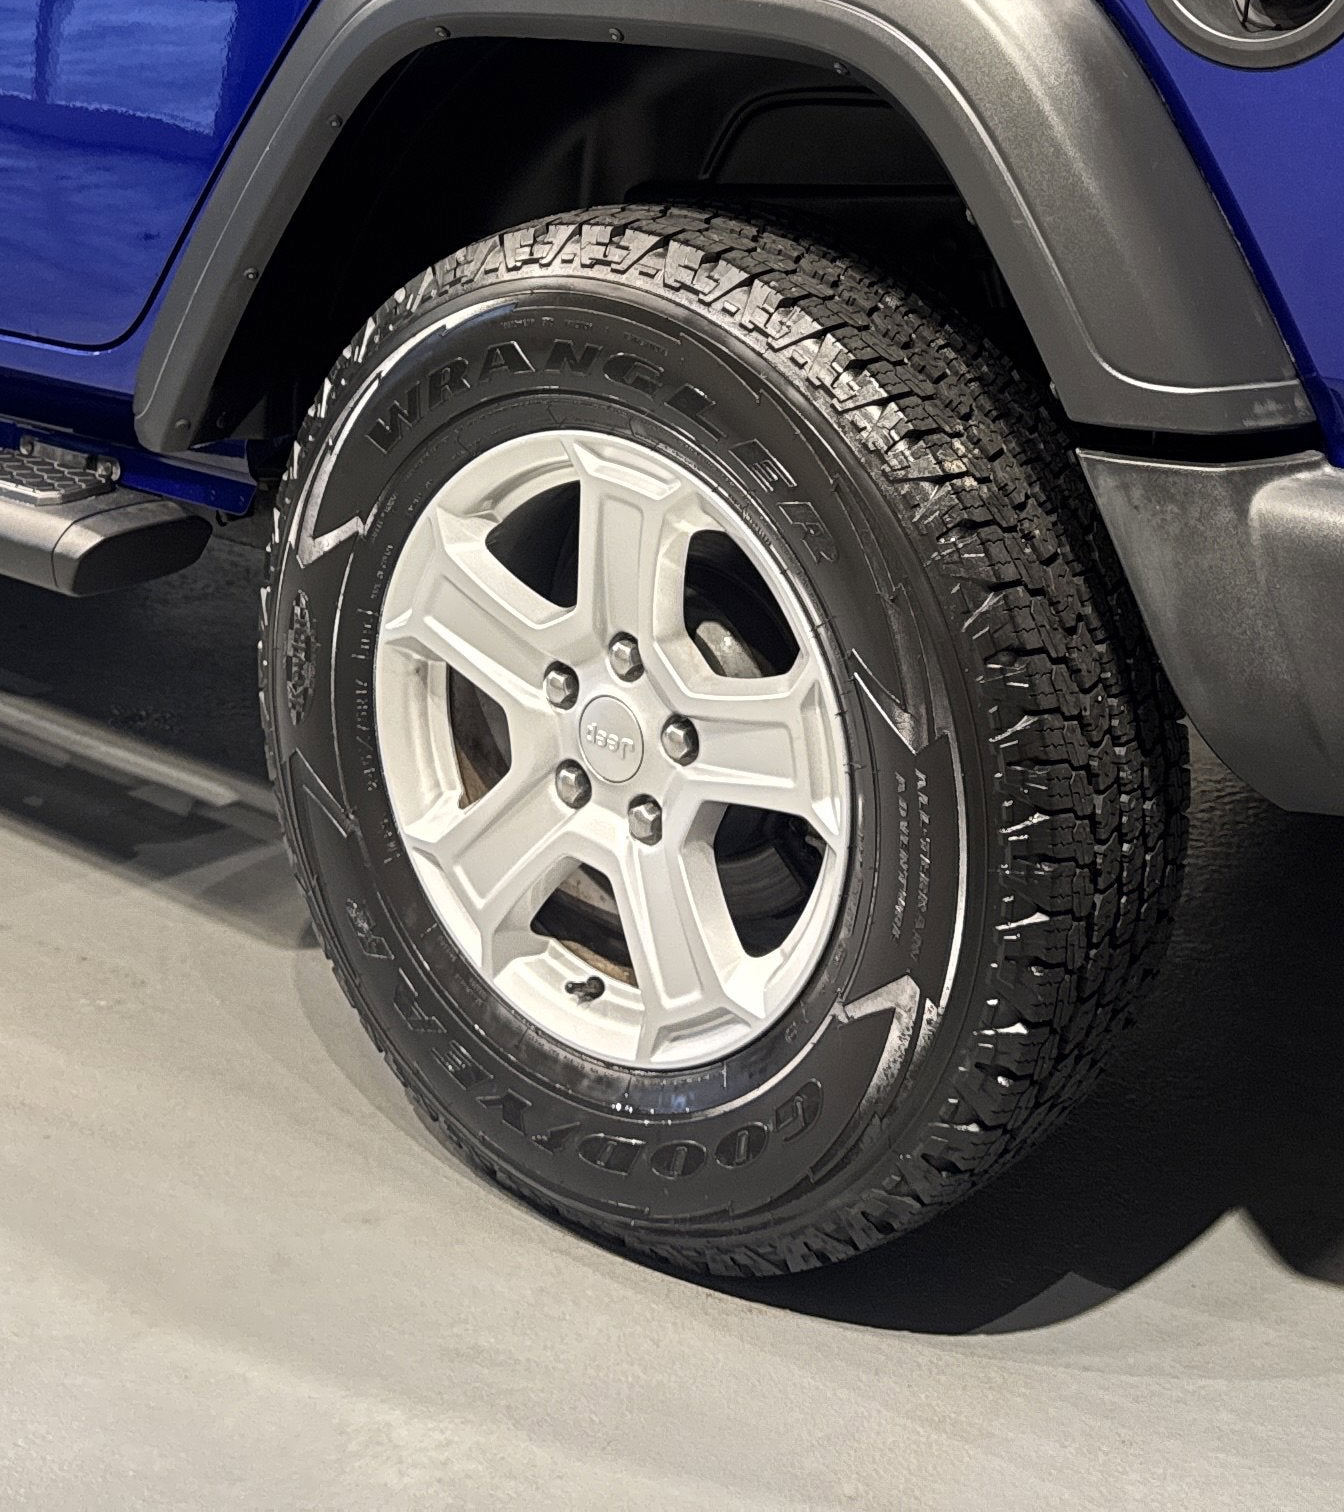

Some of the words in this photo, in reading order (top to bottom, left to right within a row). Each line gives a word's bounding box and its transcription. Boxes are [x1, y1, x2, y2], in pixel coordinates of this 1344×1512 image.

[365, 339, 838, 565] WRANGLER
[586, 722, 635, 760] Jeep
[345, 897, 824, 1180] GOODYEAR
